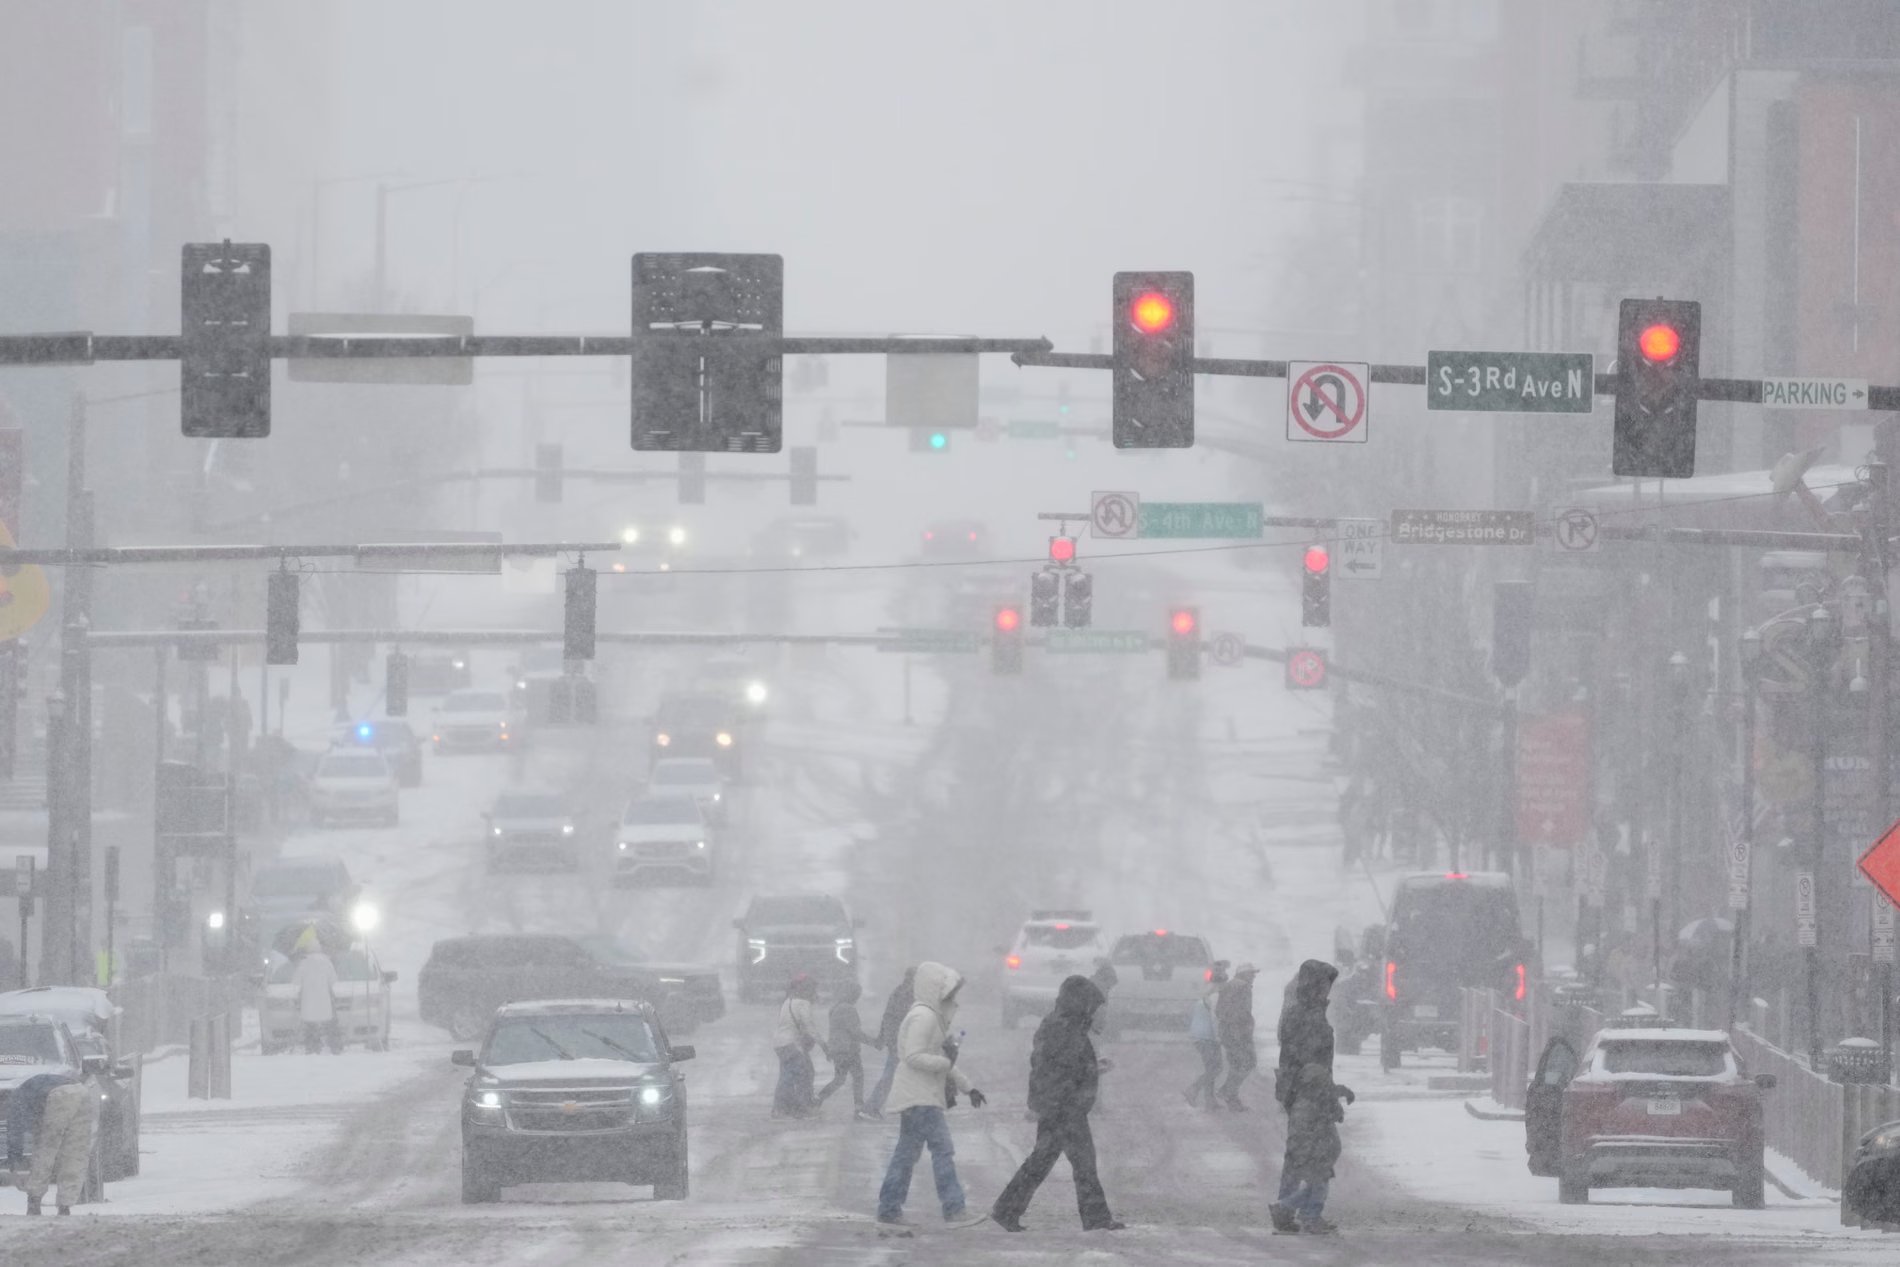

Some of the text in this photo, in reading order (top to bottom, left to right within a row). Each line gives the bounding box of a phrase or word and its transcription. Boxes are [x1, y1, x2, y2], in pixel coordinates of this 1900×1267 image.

[1521, 374, 1562, 398] Ave
[1567, 368, 1582, 399] N
[1763, 381, 1846, 405] PARKING
[1345, 524, 1377, 539] ONE
[1398, 522, 1526, 542] Bridgestone Dr
[1344, 540, 1377, 554] WAY
